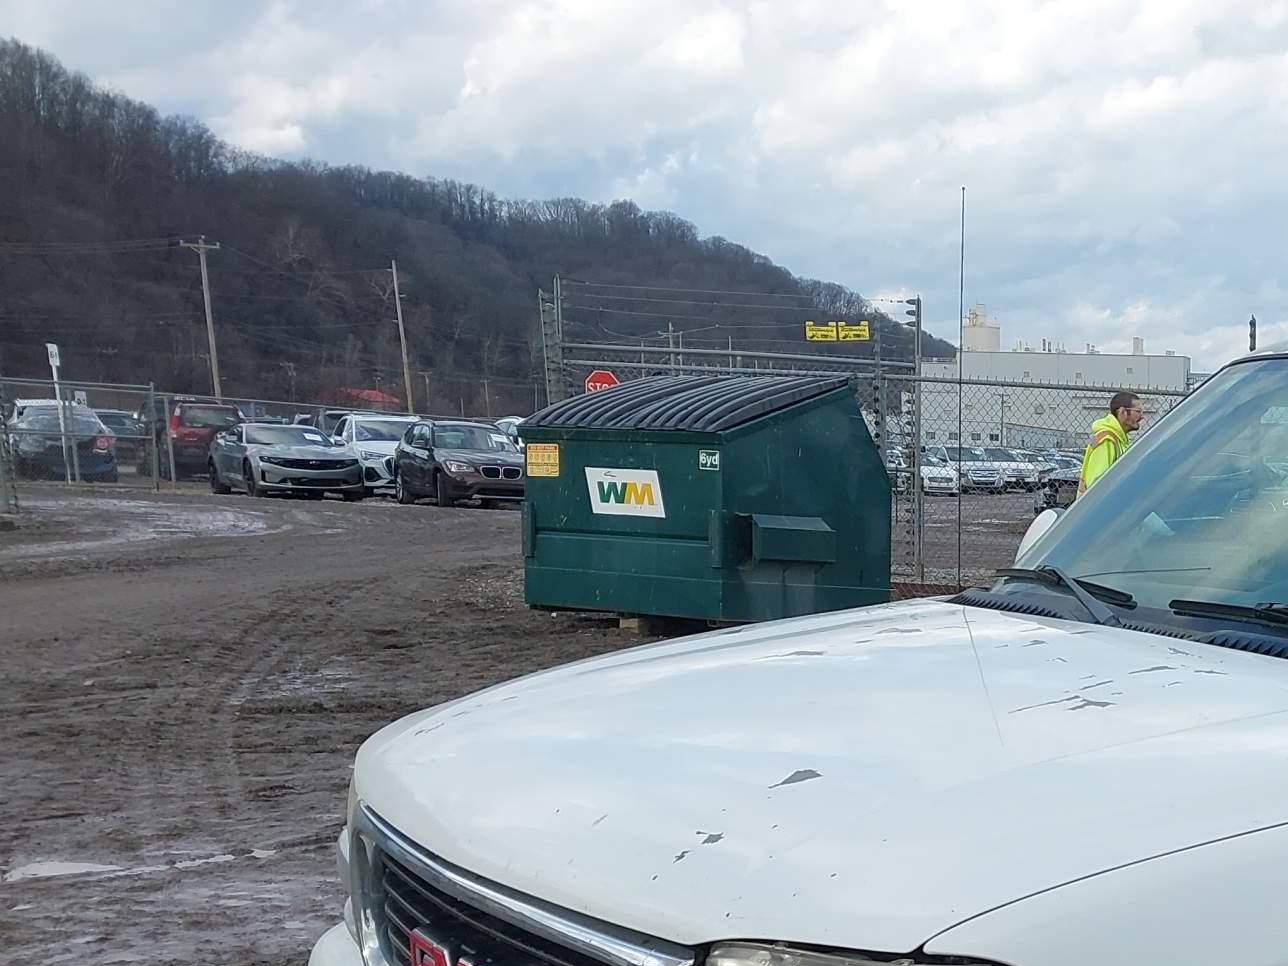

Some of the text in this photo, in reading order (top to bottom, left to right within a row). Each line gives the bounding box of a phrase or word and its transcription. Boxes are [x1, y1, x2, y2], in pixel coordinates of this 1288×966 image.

[588, 383, 614, 392] STO
[701, 453, 718, 466] 6yd
[597, 481, 656, 506] WM
